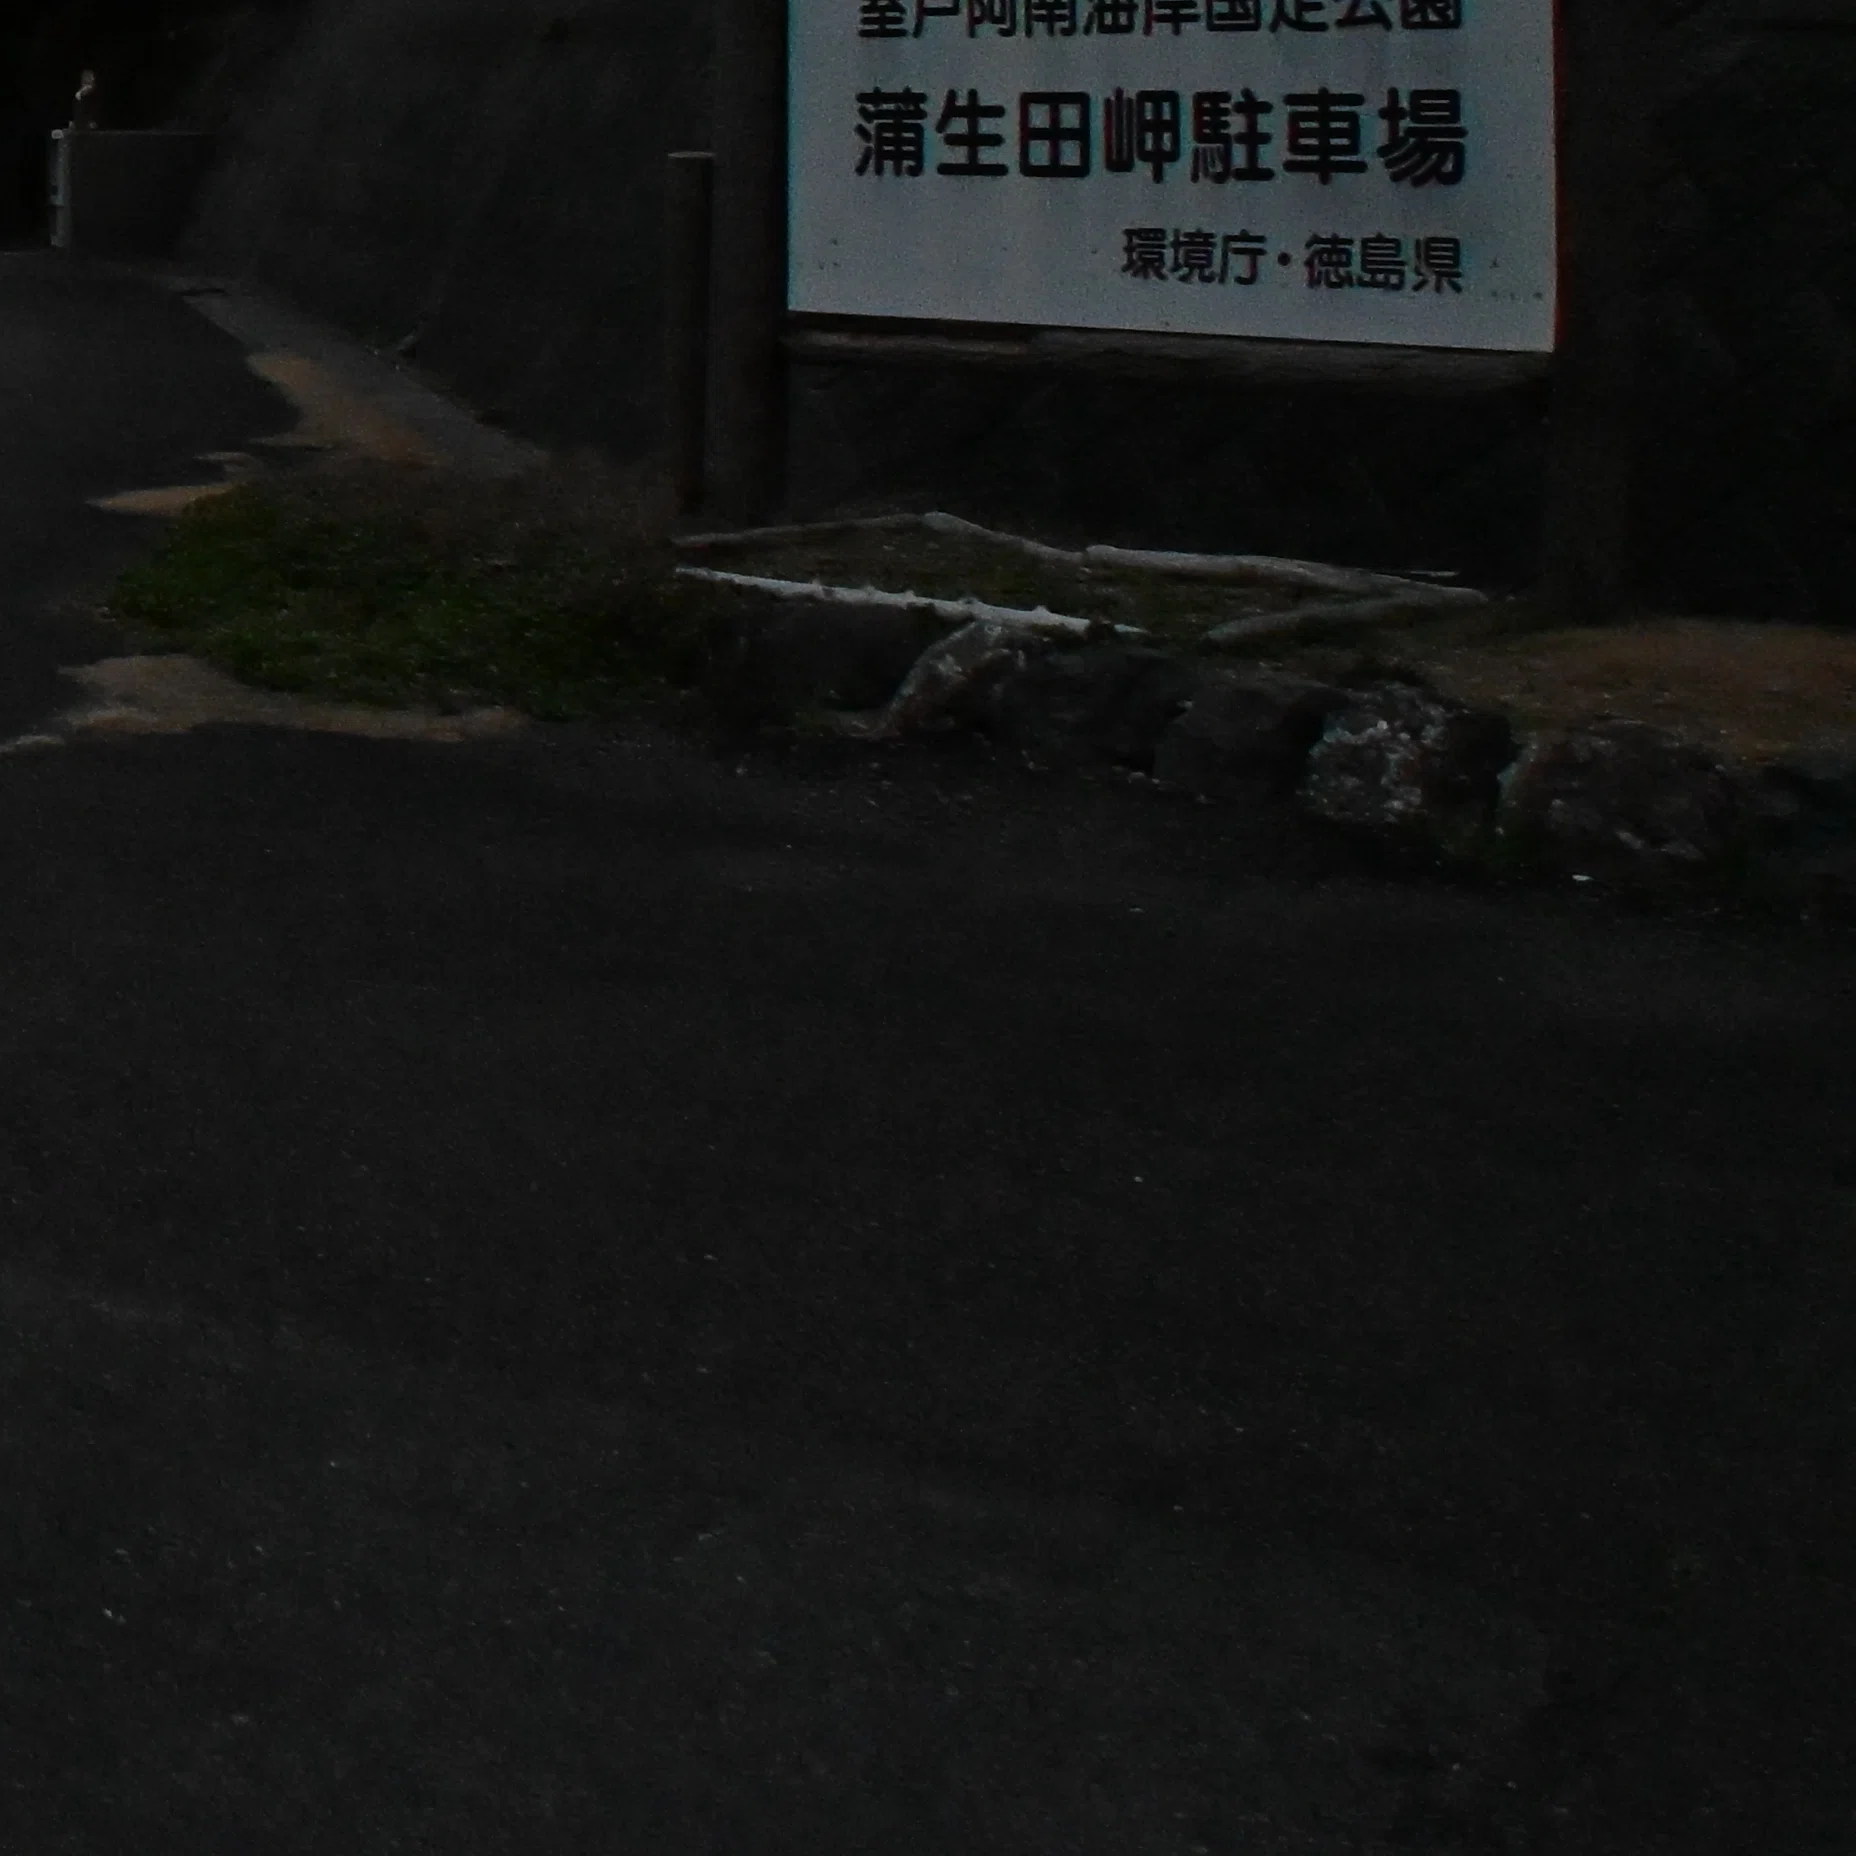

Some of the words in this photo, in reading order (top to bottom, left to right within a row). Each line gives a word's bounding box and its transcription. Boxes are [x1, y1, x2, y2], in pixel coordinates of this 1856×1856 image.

[854, 86, 1468, 187] 蒲生田岬駐車場
[1121, 227, 1463, 294] 環境庁・徳島県
